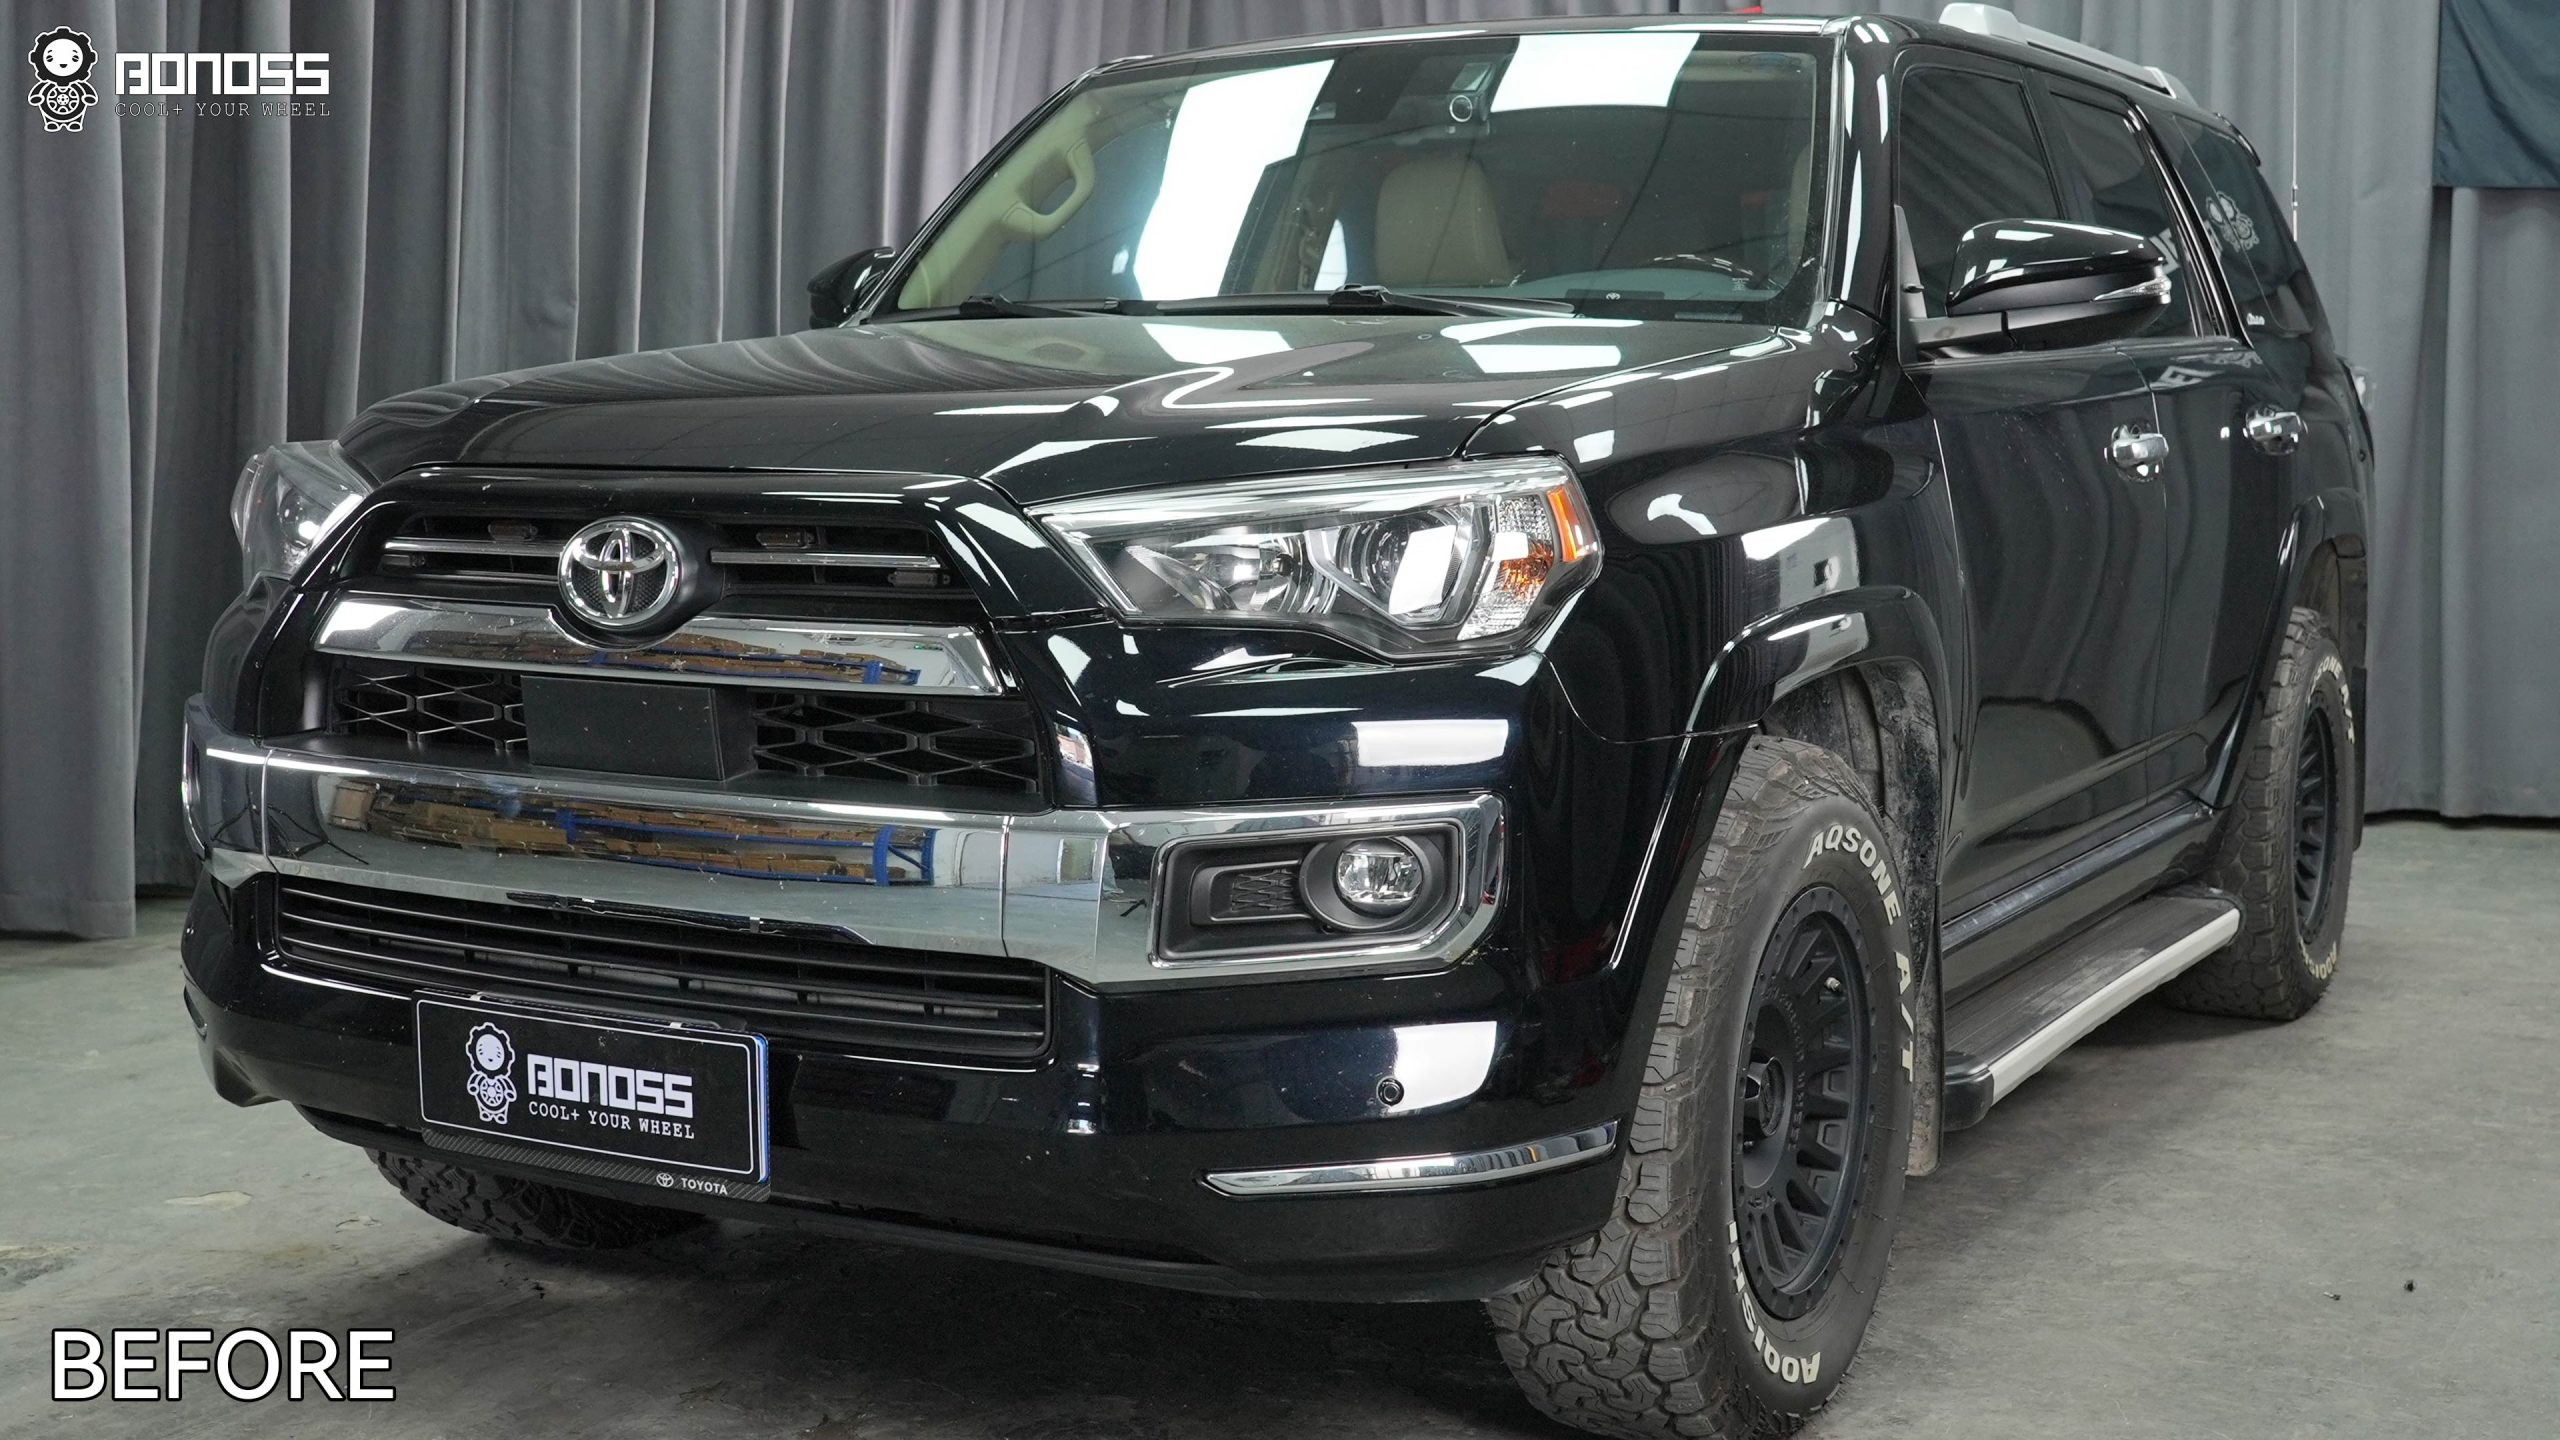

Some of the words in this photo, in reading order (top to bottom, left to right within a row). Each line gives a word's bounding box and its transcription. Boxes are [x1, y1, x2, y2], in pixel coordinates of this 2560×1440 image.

[1802, 824, 1902, 926] AQSONE
[1895, 951, 1914, 1083] A/T
[527, 1053, 693, 1118] BONOSS
[529, 1101, 580, 1120] COOL+
[588, 1110, 632, 1131] YOUR
[639, 1118, 695, 1139] WHEEL
[681, 1177, 729, 1196] TOYOTA
